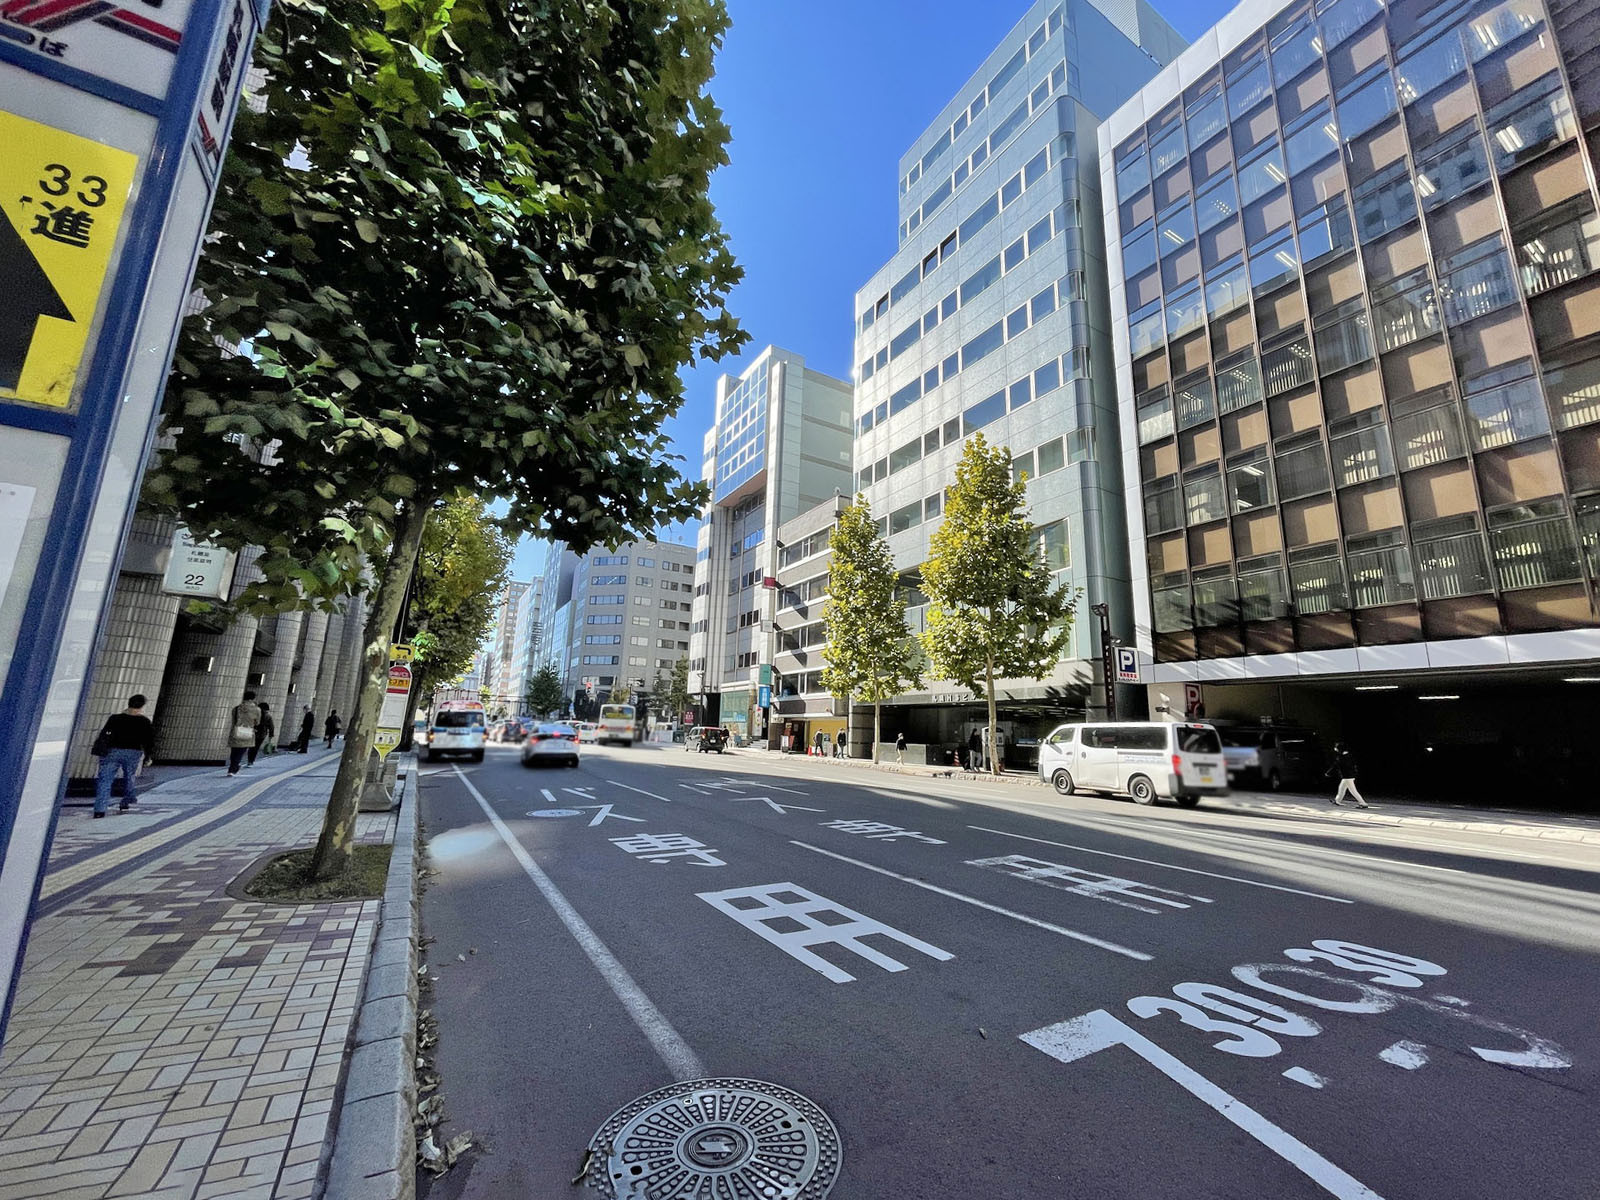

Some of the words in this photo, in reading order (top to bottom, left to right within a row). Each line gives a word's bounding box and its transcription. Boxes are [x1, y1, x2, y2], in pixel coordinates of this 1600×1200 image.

[38, 163, 109, 208] 33
[184, 573, 205, 586] 22
[1120, 651, 1133, 670] P
